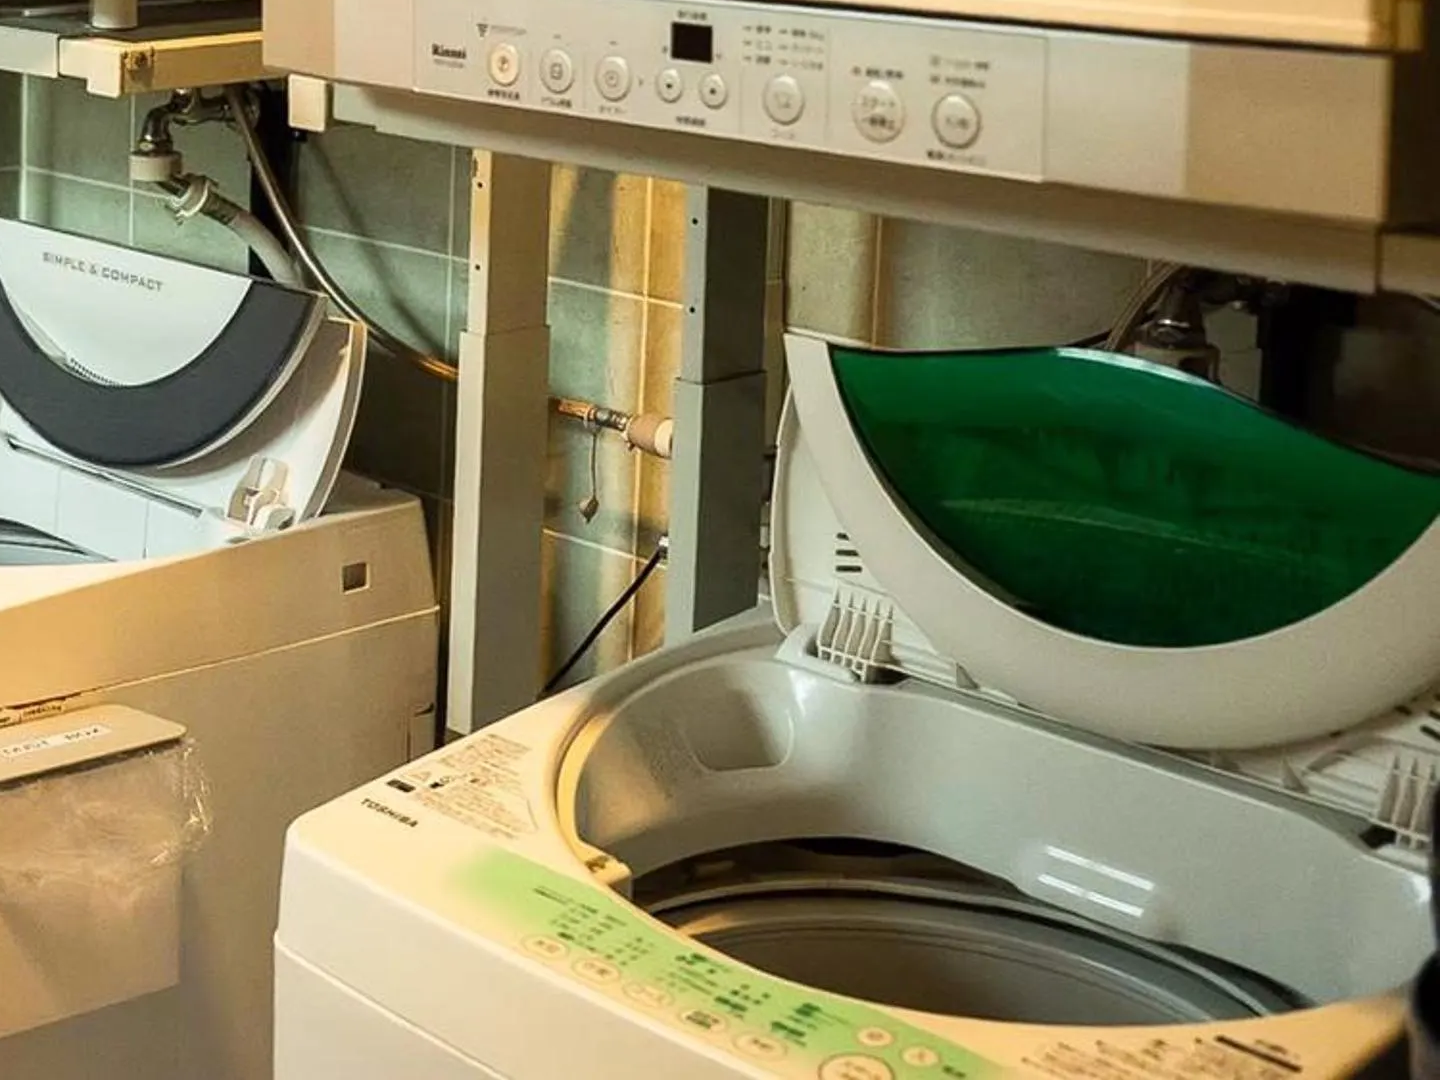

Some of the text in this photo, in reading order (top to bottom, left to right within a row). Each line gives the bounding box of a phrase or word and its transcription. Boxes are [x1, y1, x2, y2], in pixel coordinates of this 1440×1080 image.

[431, 43, 467, 60] Rinnai
[42, 251, 164, 293] SIMPLE & COMPACT
[360, 797, 419, 828] TOSHIBA
